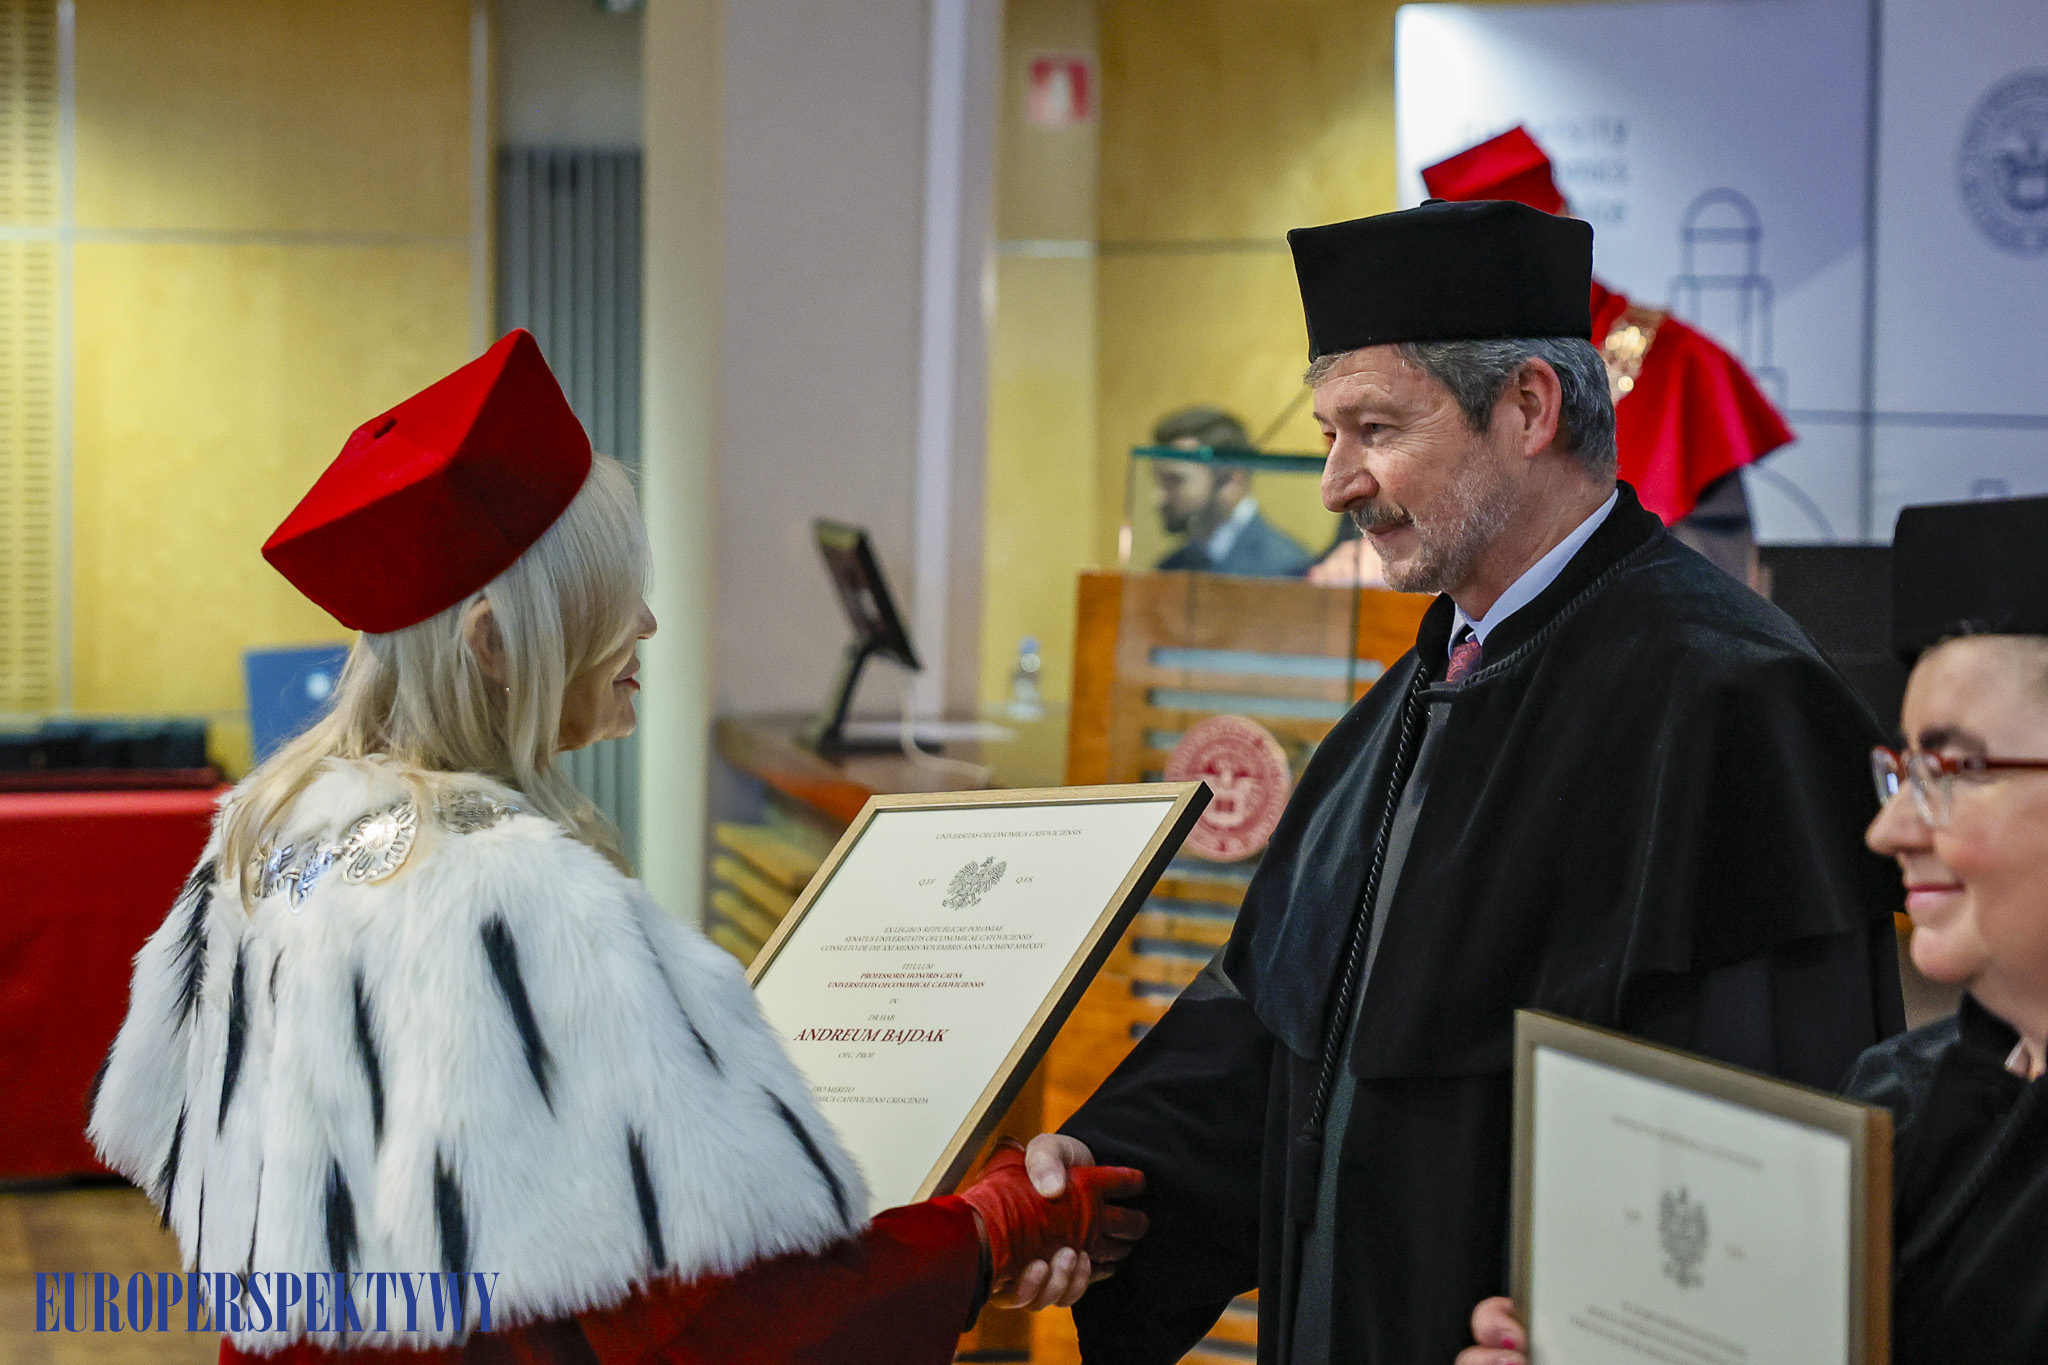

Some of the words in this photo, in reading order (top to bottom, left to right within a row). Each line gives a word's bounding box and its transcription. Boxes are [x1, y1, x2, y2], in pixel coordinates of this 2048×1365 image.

[935, 832, 979, 840] UNIVERSITAS
[979, 831, 1028, 839] OECONOMICA
[1028, 829, 1083, 837] CATOVICIENSIS
[967, 925, 1004, 933] POLONIAE
[902, 963, 935, 971] TITULUM
[860, 972, 905, 980] PROFESSORIS
[905, 972, 939, 980] HONORIS
[827, 981, 878, 989] UNIVERSITATIS
[878, 981, 931, 989] OECONOMICAE
[931, 980, 985, 988] CATOVICIENSIS
[793, 1028, 882, 1042] ANDREUM
[880, 1028, 950, 1046] BAJDAK
